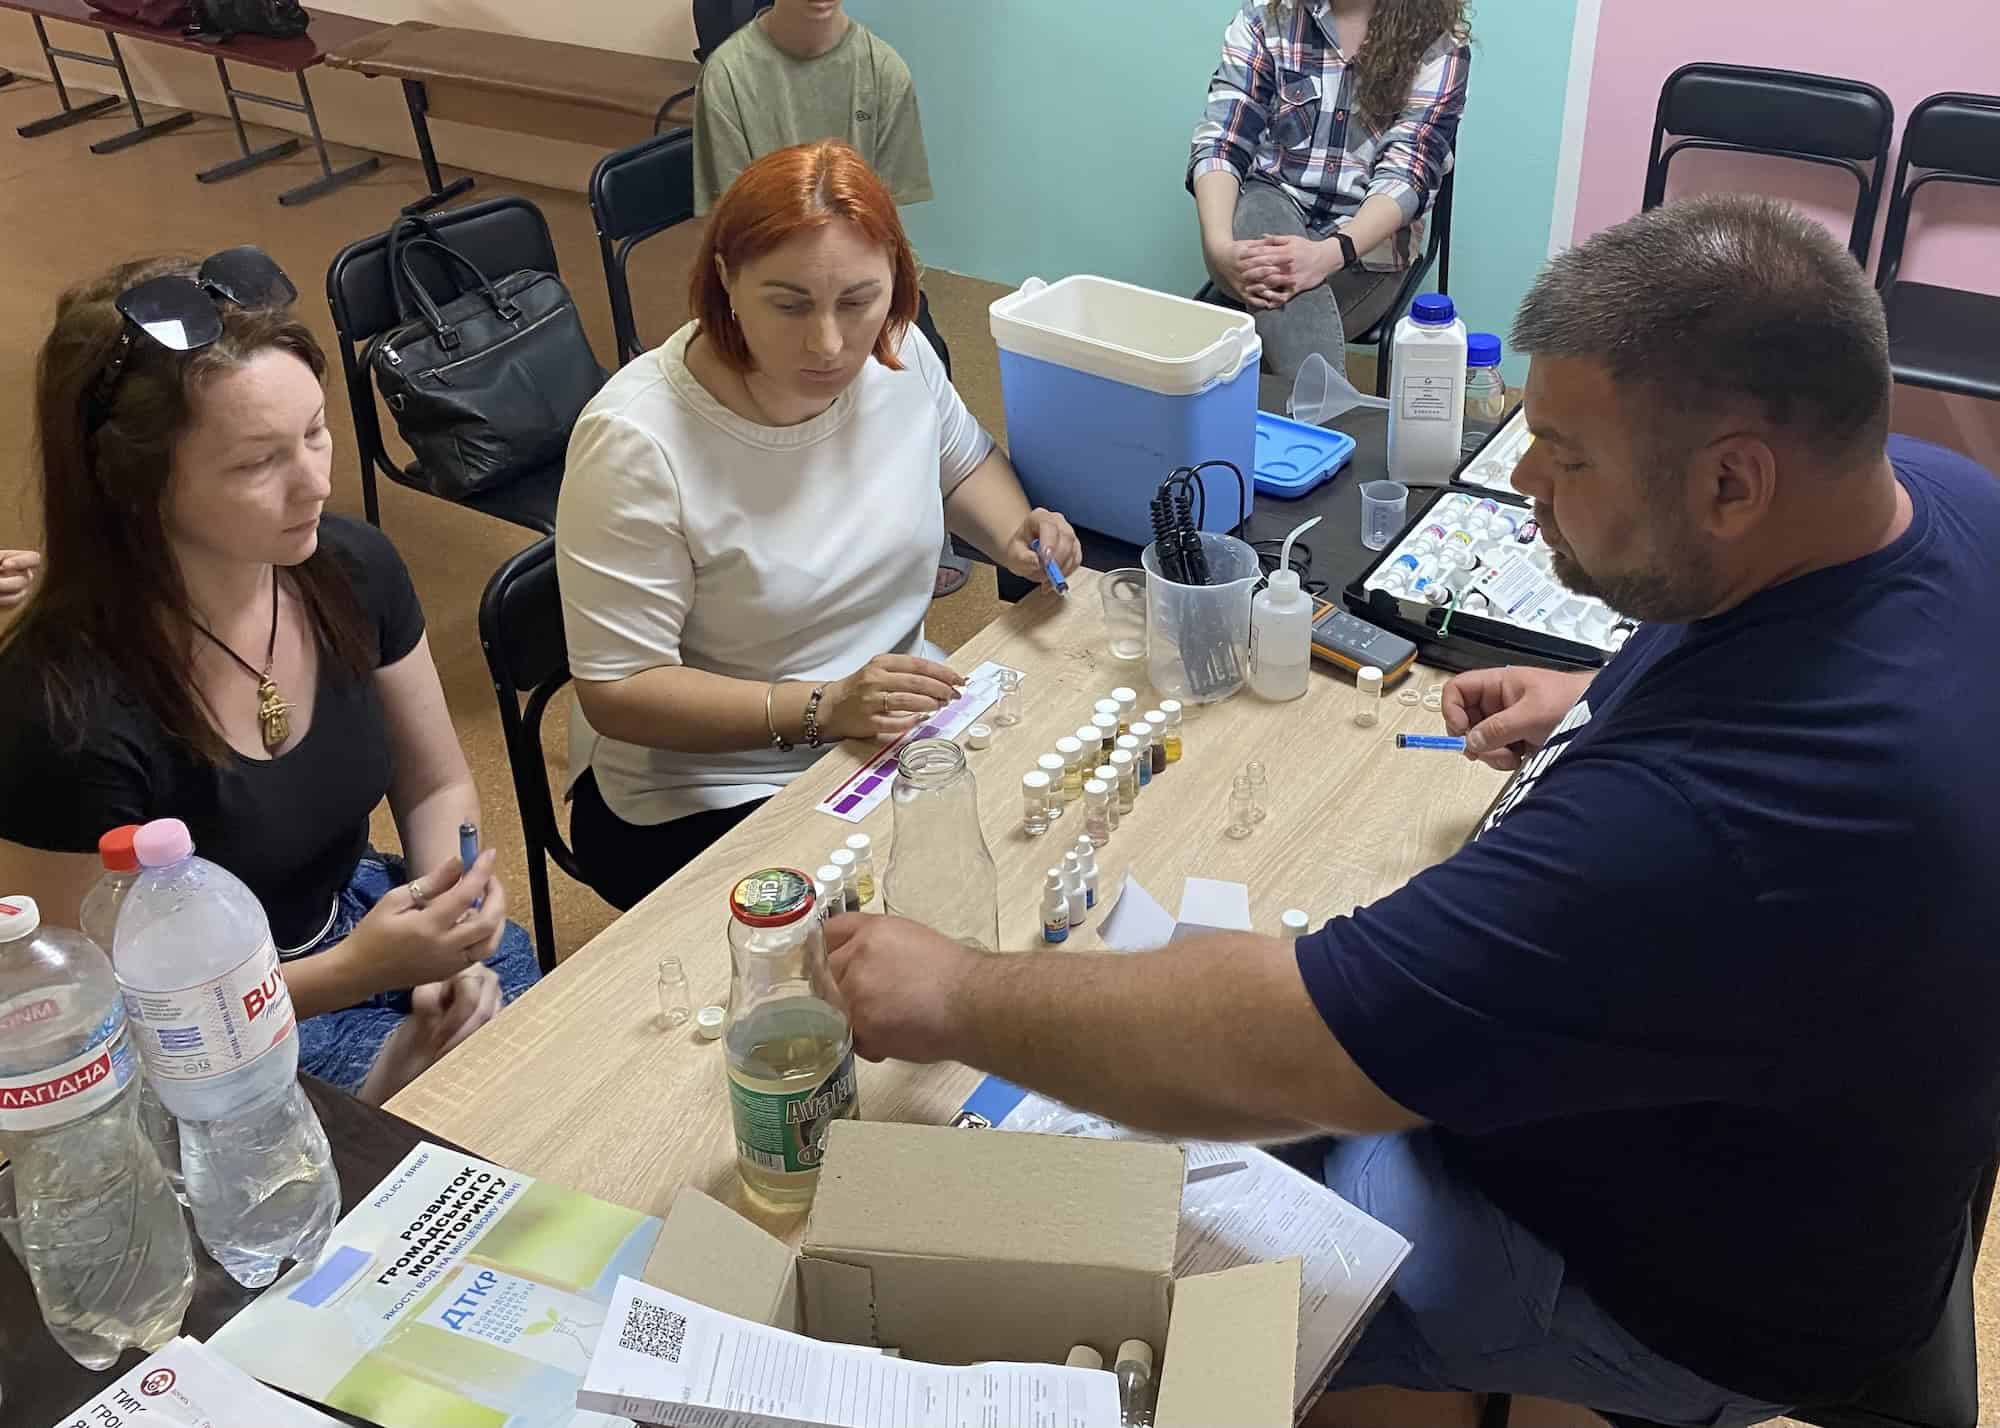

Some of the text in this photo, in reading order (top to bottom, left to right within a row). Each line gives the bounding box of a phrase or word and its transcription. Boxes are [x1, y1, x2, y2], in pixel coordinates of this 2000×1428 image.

[3, 1063, 107, 1106] ЛАГІДНА
[373, 1153, 430, 1208] POLICY BRIEF
[400, 1166, 477, 1241] РОЗВИТОК
[377, 1172, 491, 1286] ГРОМАДСЬКОГО
[383, 1182, 521, 1321] ЯКОСТІ ВОД НА МІСЦЕВОМУ РІВНІ
[407, 1177, 506, 1277] МОНІТОРИНГУ
[441, 1270, 498, 1330] ДТКР
[112, 1388, 147, 1414] ТИП
